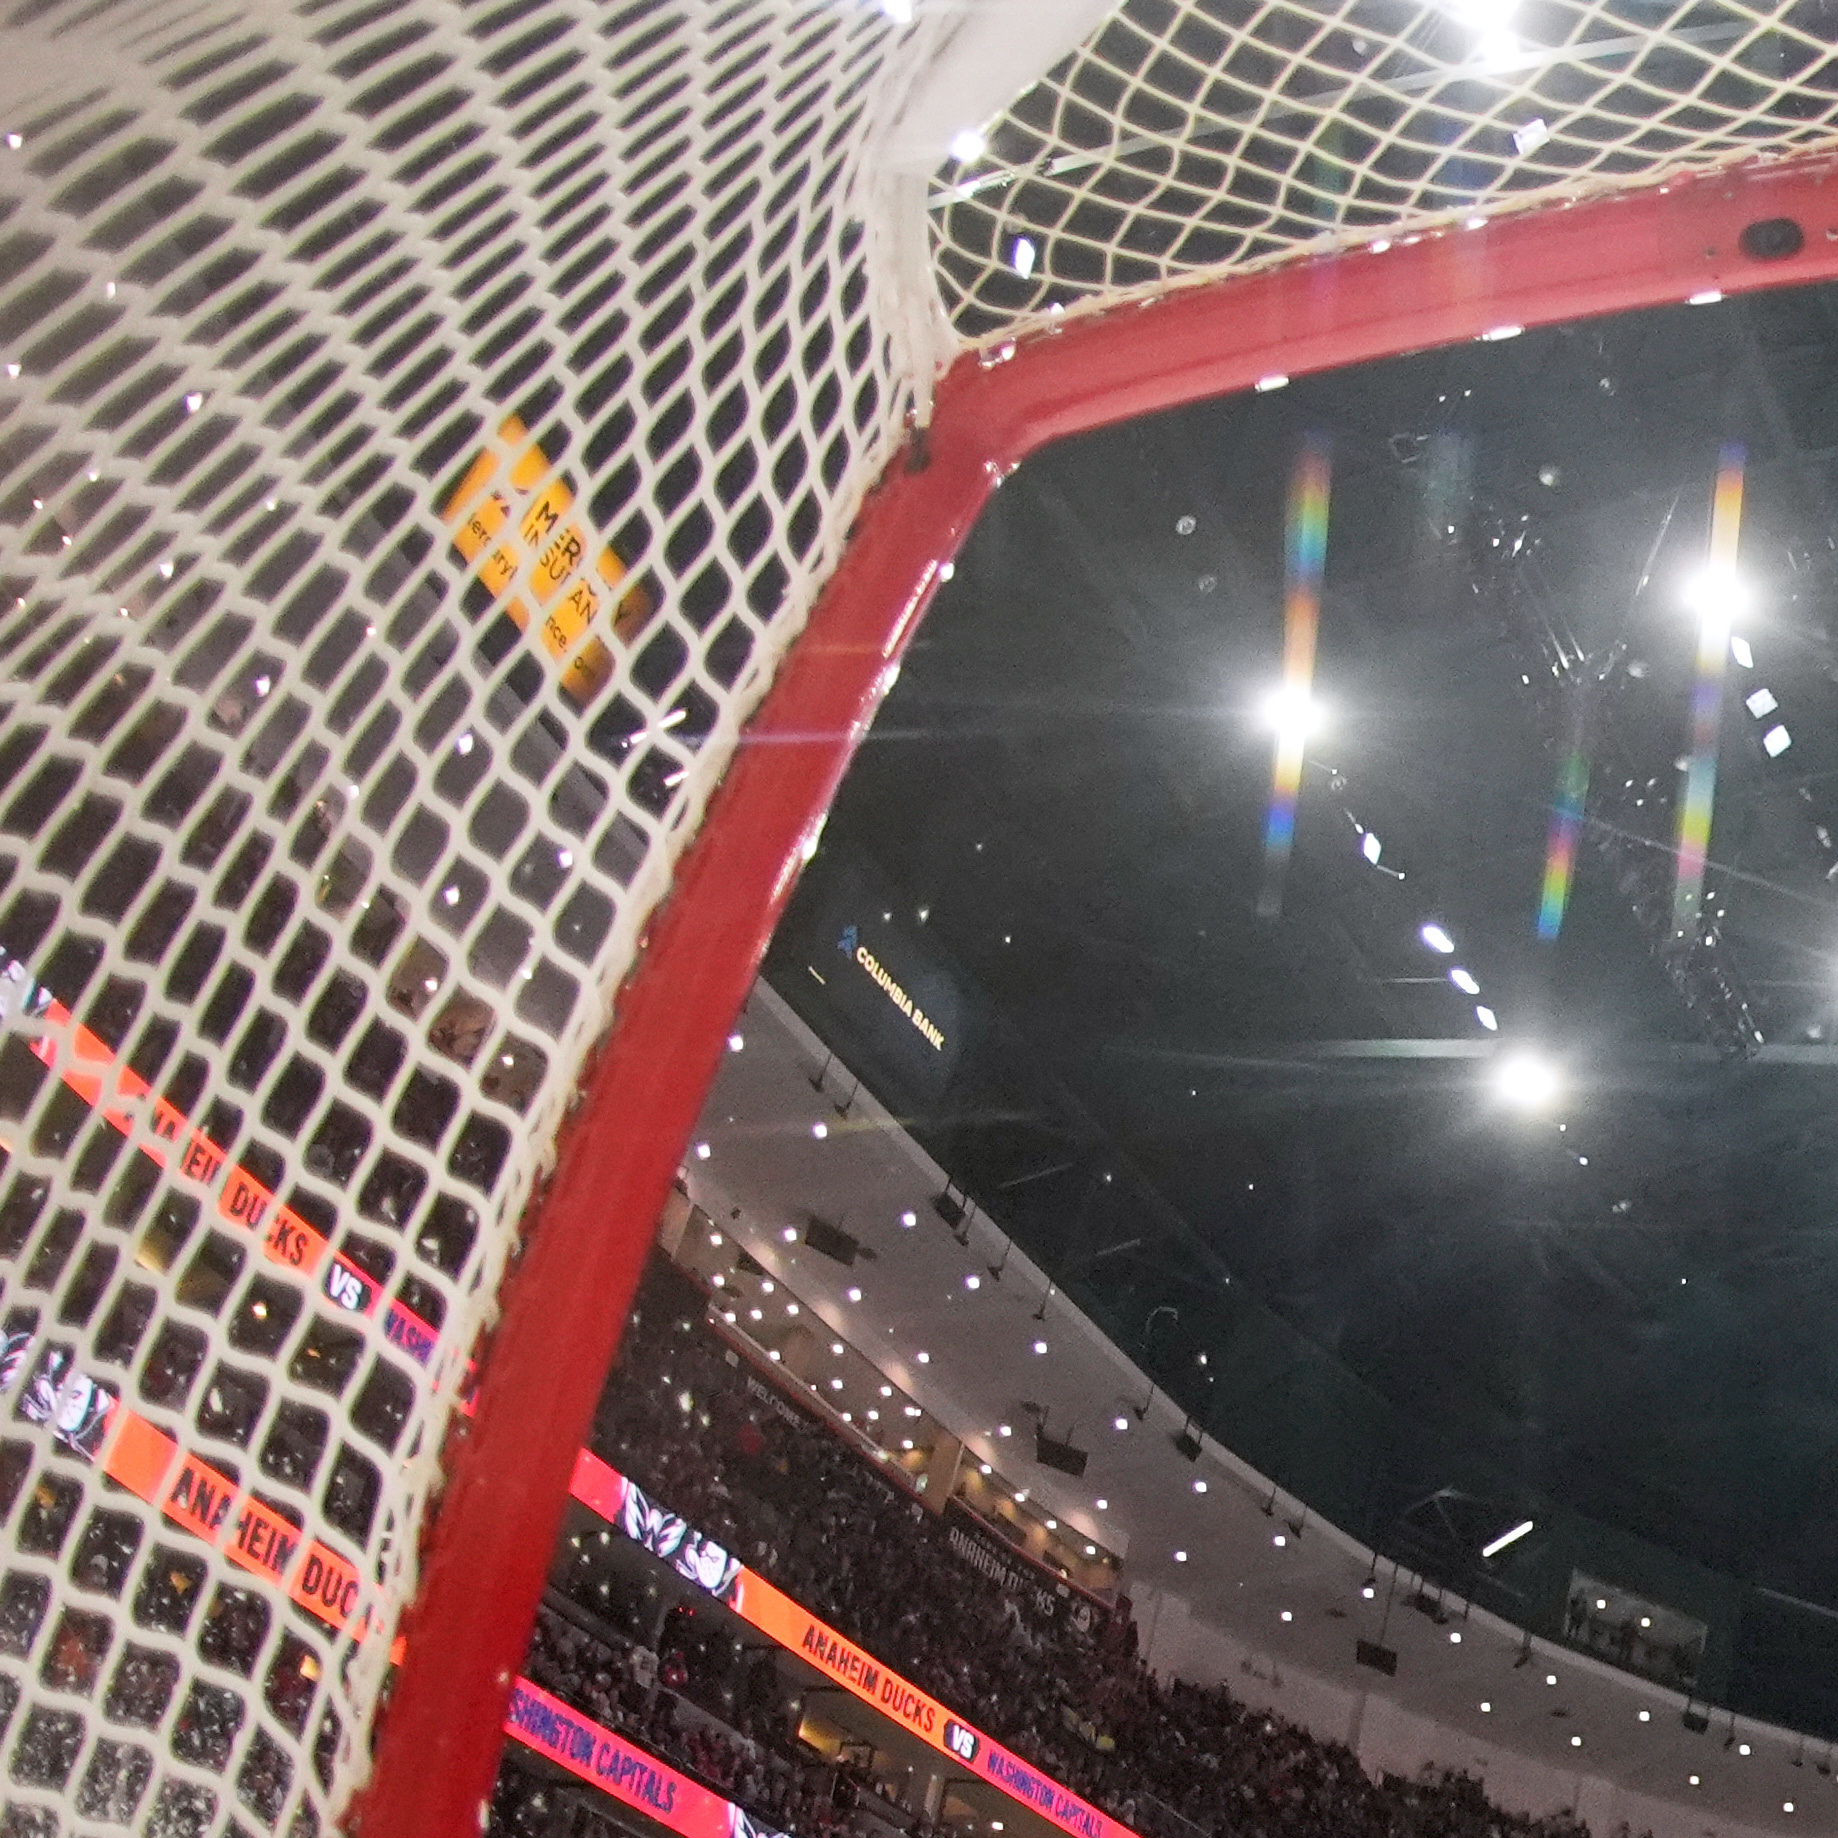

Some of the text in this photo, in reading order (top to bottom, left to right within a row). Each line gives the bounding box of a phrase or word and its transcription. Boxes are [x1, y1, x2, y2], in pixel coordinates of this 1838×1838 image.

[857, 946, 945, 1052] COLUMBIA BANK
[329, 1264, 363, 1310] VS
[801, 1623, 880, 1698] ANAHEIM
[880, 1681, 937, 1733] DUCKS
[952, 1724, 977, 1760] VS
[595, 1742, 678, 1815] CAPITALS
